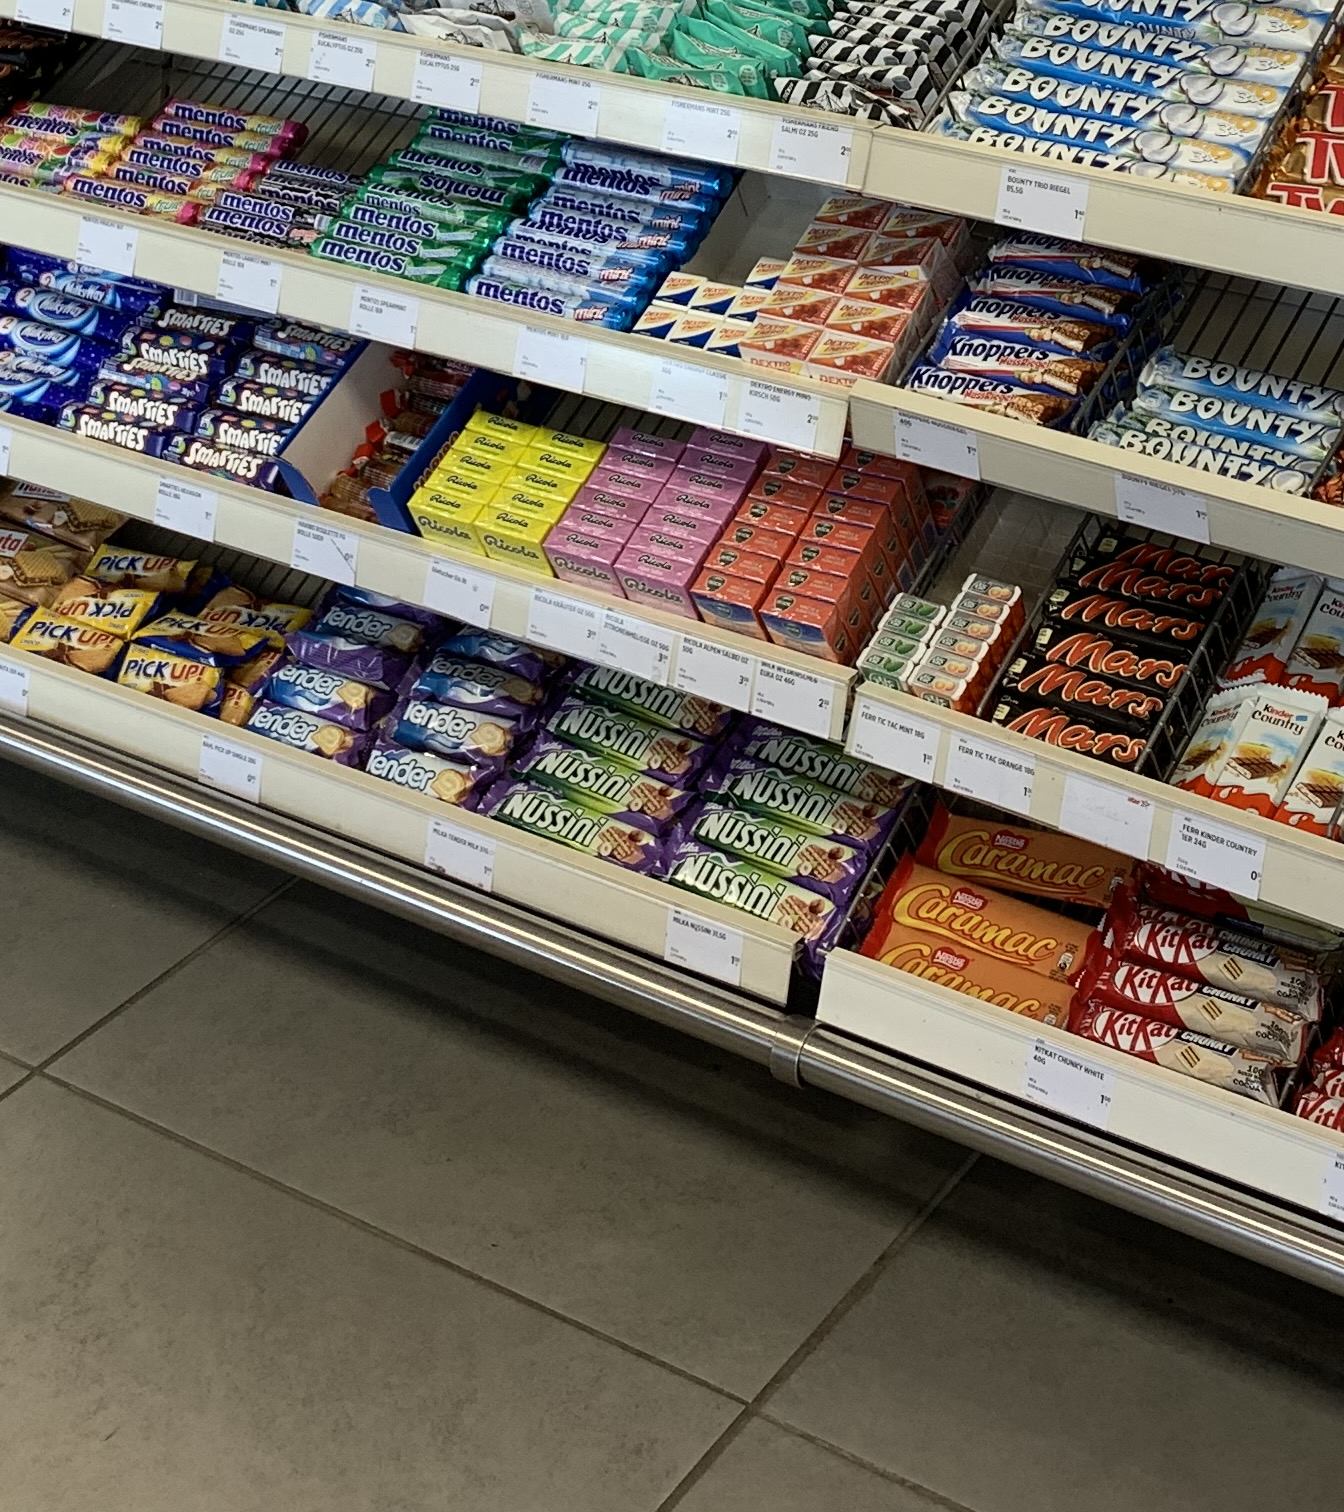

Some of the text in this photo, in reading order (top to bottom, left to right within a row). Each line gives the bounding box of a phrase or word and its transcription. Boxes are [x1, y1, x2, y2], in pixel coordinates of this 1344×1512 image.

[174, 102, 247, 130] mentos
[72, 178, 146, 207] mentos
[948, 337, 1052, 363] Knoppers
[637, 553, 672, 571] Ricola
[170, 661, 206, 684] UP!
[861, 711, 925, 739] FERR TIC TAC MINT 18G
[1251, 711, 1306, 737] Country
[1263, 703, 1295, 719] Kinder
[958, 744, 974, 756] FERR
[998, 758, 1022, 773] ORANGE
[1024, 766, 1035, 777] 18G
[1183, 823, 1258, 857] FERR KINDER COUNTRY
[935, 831, 1106, 890] Caramac
[1094, 1009, 1175, 1054] KitKat
